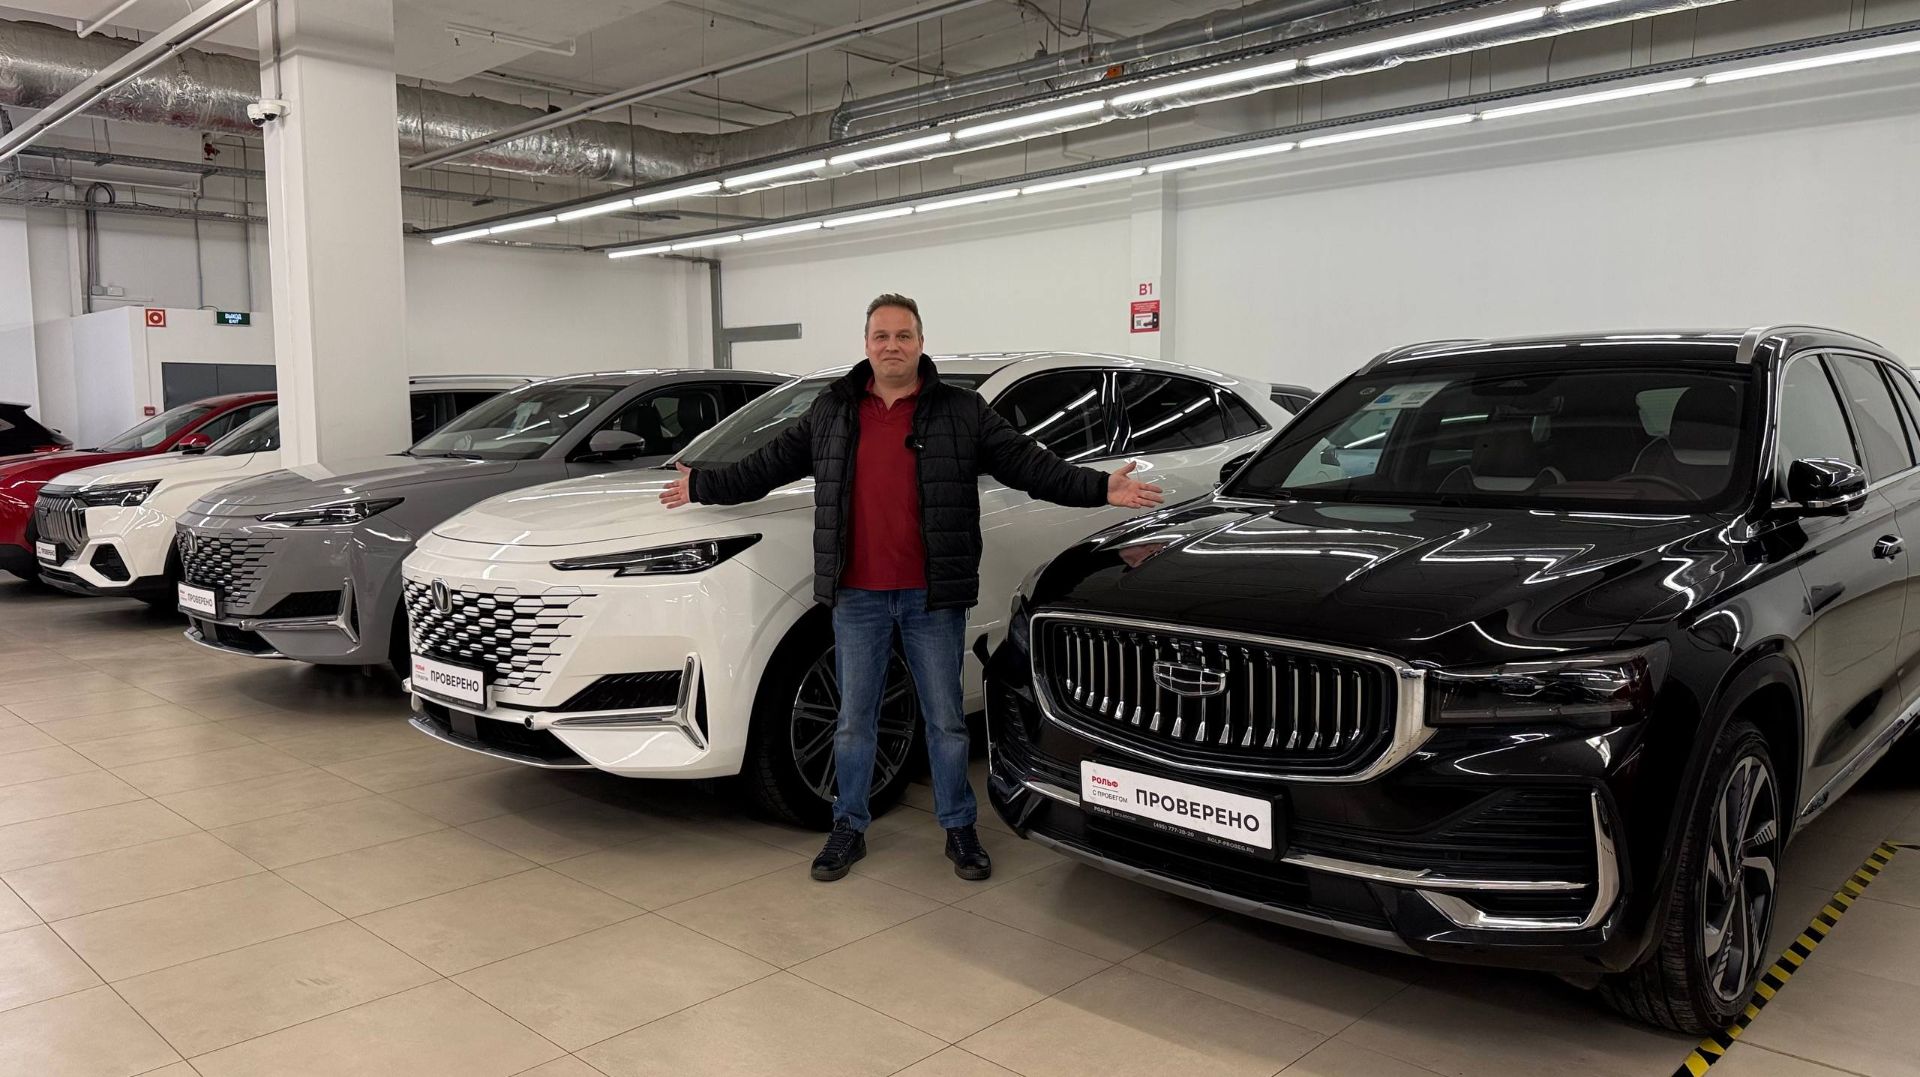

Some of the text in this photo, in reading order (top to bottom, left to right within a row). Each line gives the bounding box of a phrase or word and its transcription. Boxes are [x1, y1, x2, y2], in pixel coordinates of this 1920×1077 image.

[430, 670, 479, 692] ПРОВЕРЕНО
[1091, 775, 1119, 788] РОЛЬФ
[1097, 791, 1128, 803] ПРОБЕГОМ
[1136, 788, 1259, 832] ПРОВЕРЕНО
